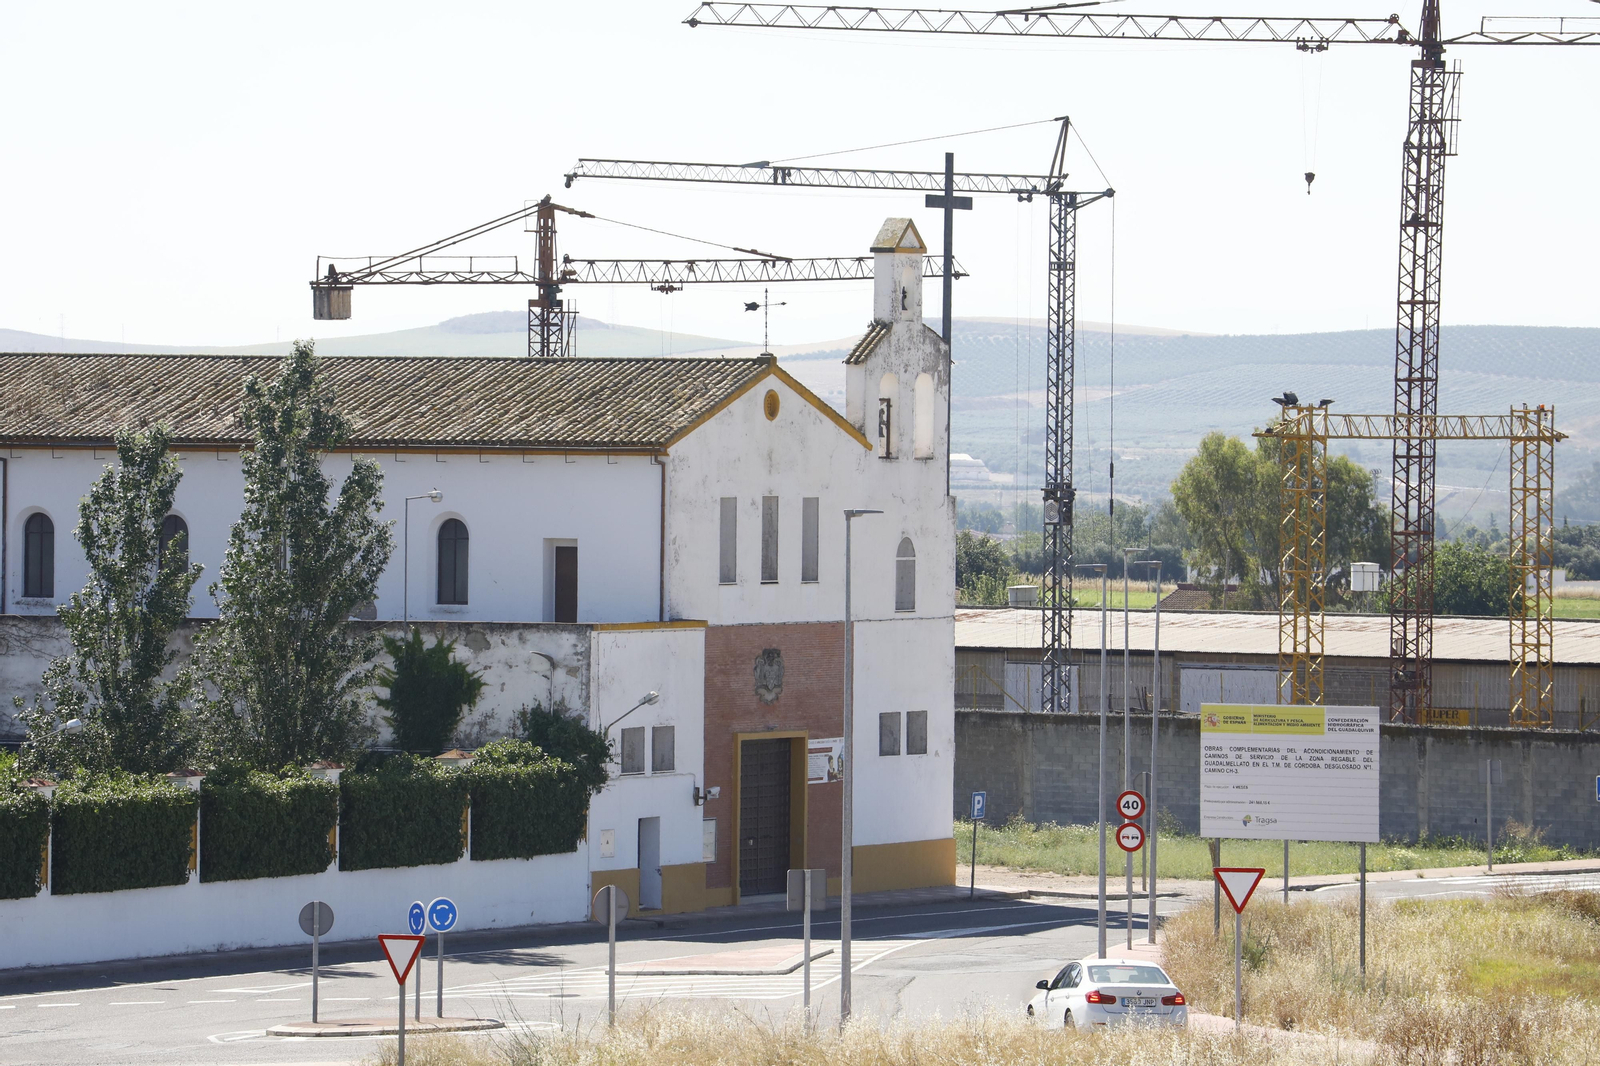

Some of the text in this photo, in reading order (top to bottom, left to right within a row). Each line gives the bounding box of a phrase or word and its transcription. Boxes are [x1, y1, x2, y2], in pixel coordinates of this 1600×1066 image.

[974, 796, 982, 815] P
[1122, 800, 1139, 810] 40
[1255, 816, 1277, 825] Tragsa
